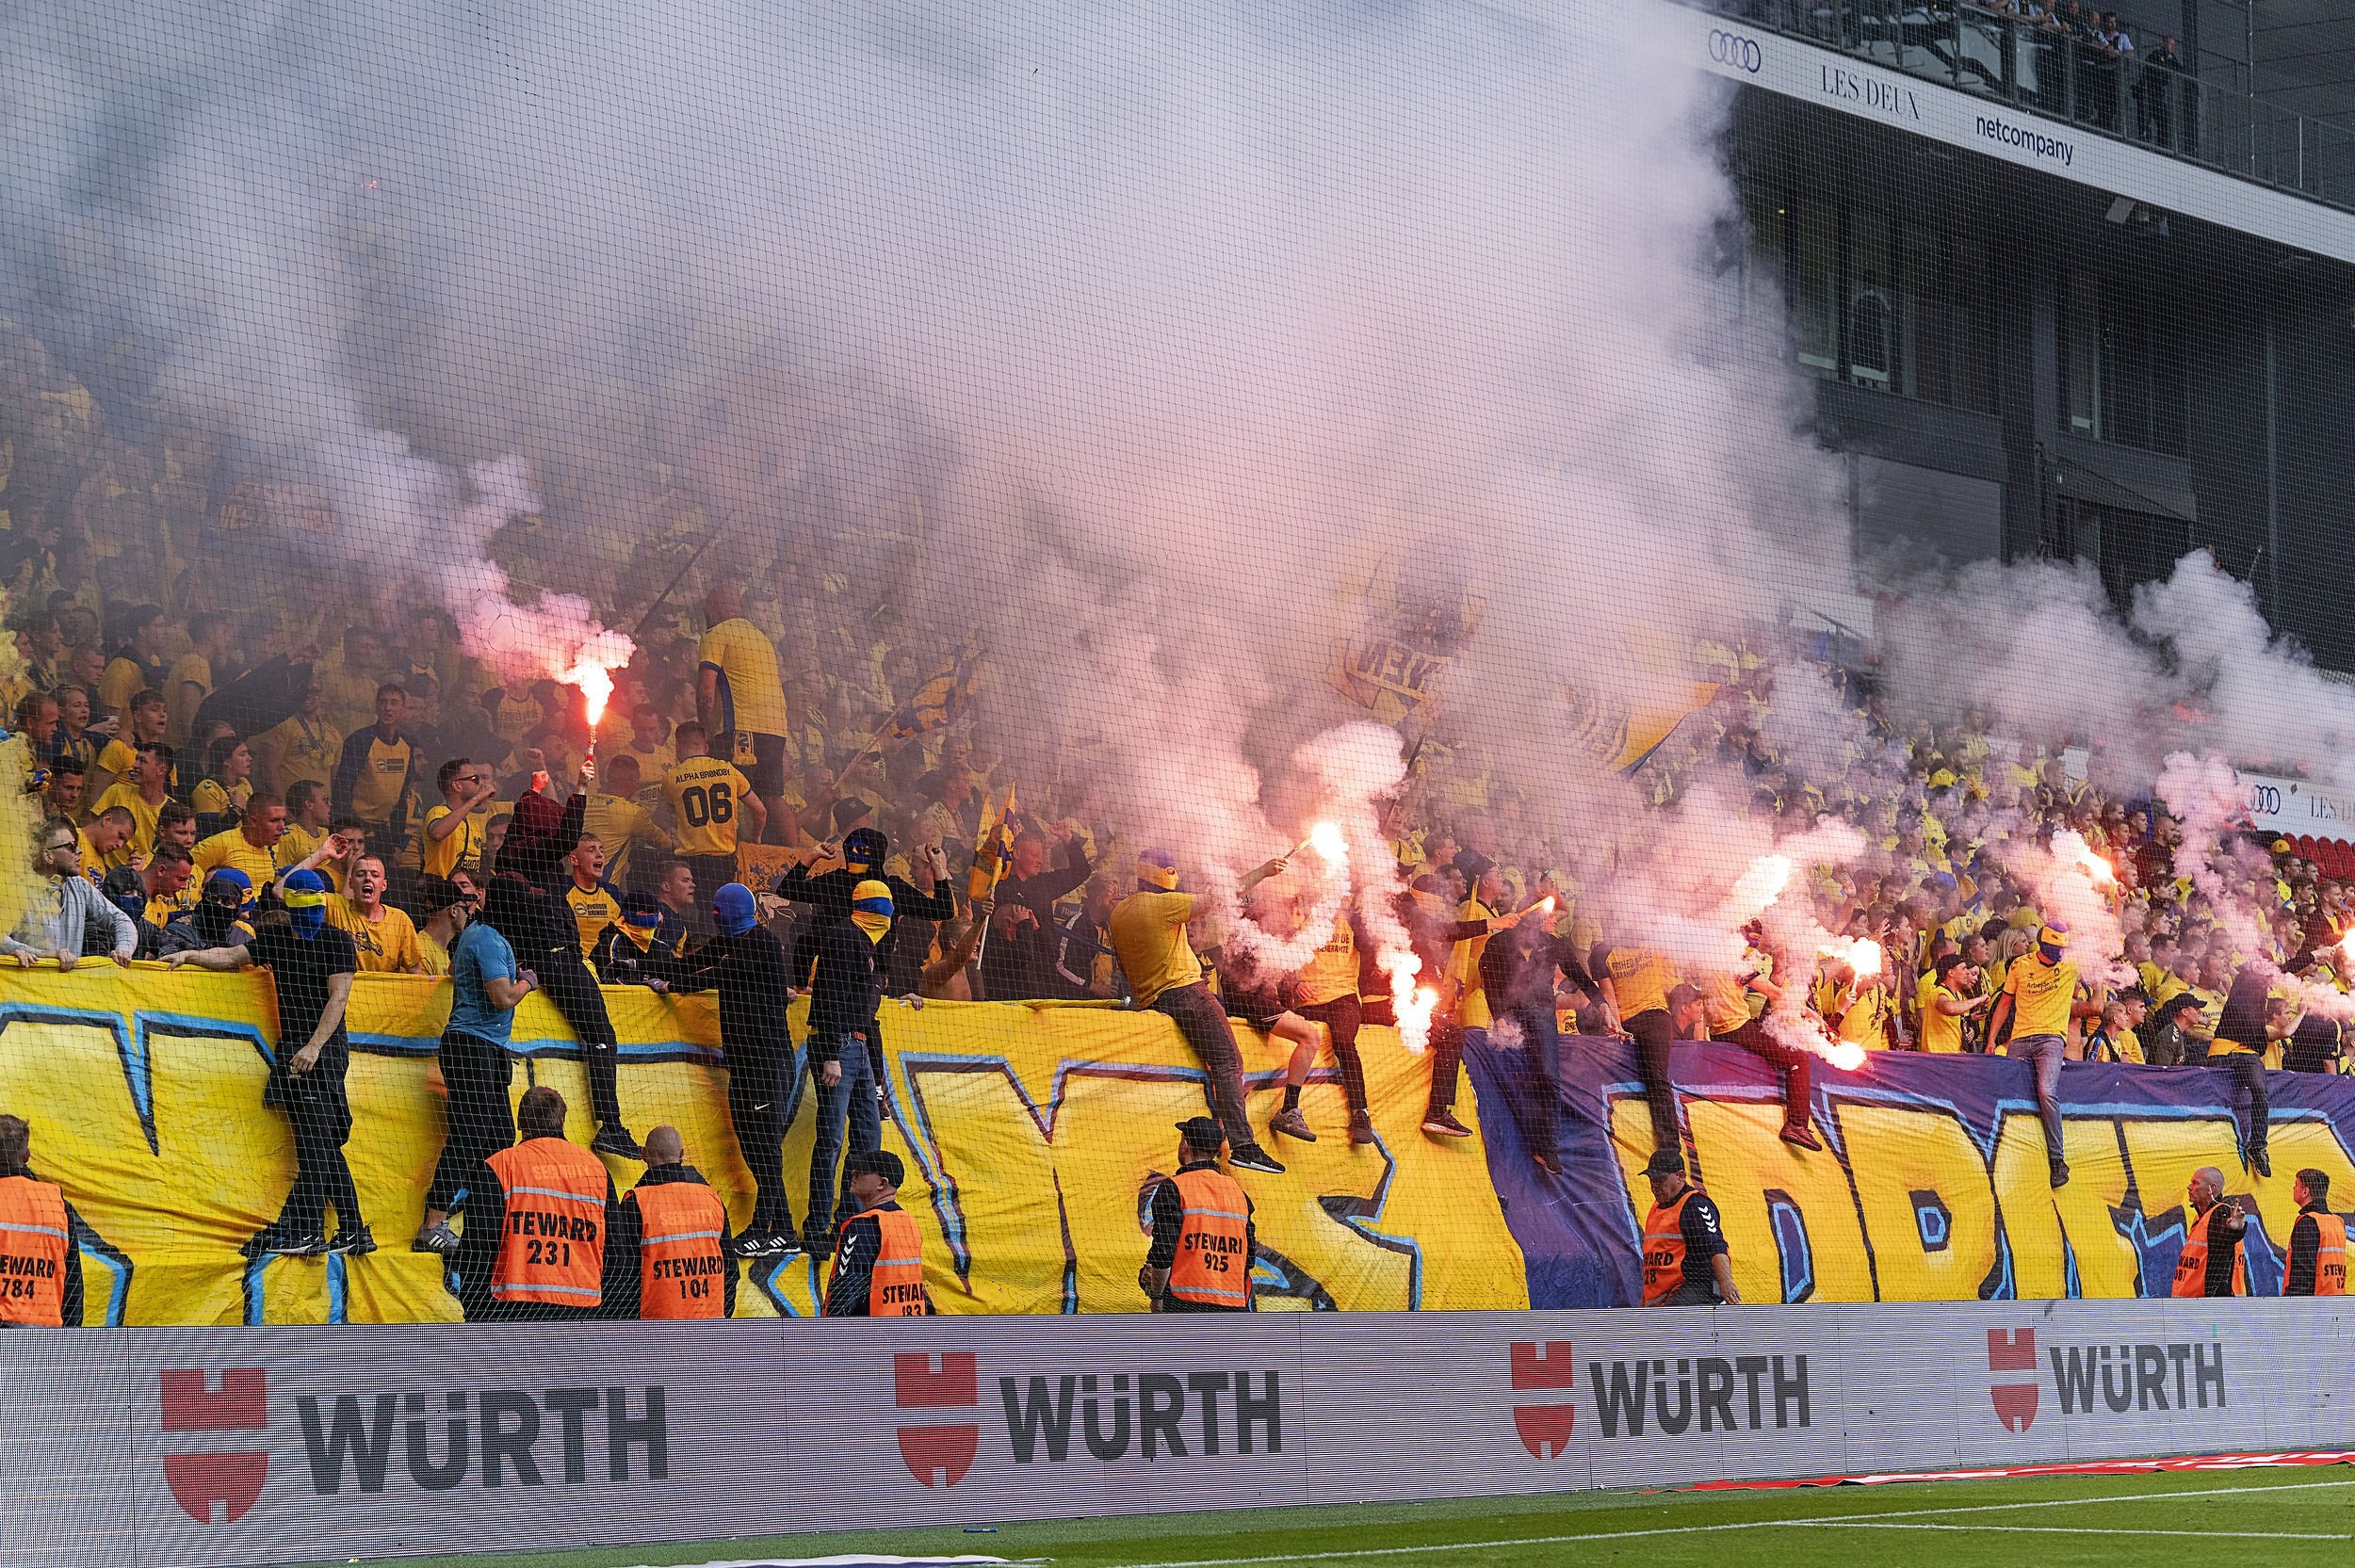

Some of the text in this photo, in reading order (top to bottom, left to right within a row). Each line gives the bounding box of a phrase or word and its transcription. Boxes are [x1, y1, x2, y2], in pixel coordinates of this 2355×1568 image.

[1821, 66, 1921, 121] LES DEUX
[1975, 115, 2073, 167] netcompany
[675, 772, 700, 784] ALPHA
[681, 782, 733, 828] 06
[528, 1239, 570, 1267] 231
[653, 1255, 723, 1280] STEWARD
[1204, 1252, 1229, 1272] 925
[0, 1277, 35, 1300] 784
[679, 1278, 709, 1300] 104
[1588, 1354, 1811, 1439] WÜRTH
[2049, 1343, 2227, 1414] WÜRTH
[295, 1384, 669, 1496] WÜRTH
[999, 1370, 1282, 1464] WÜRTH
